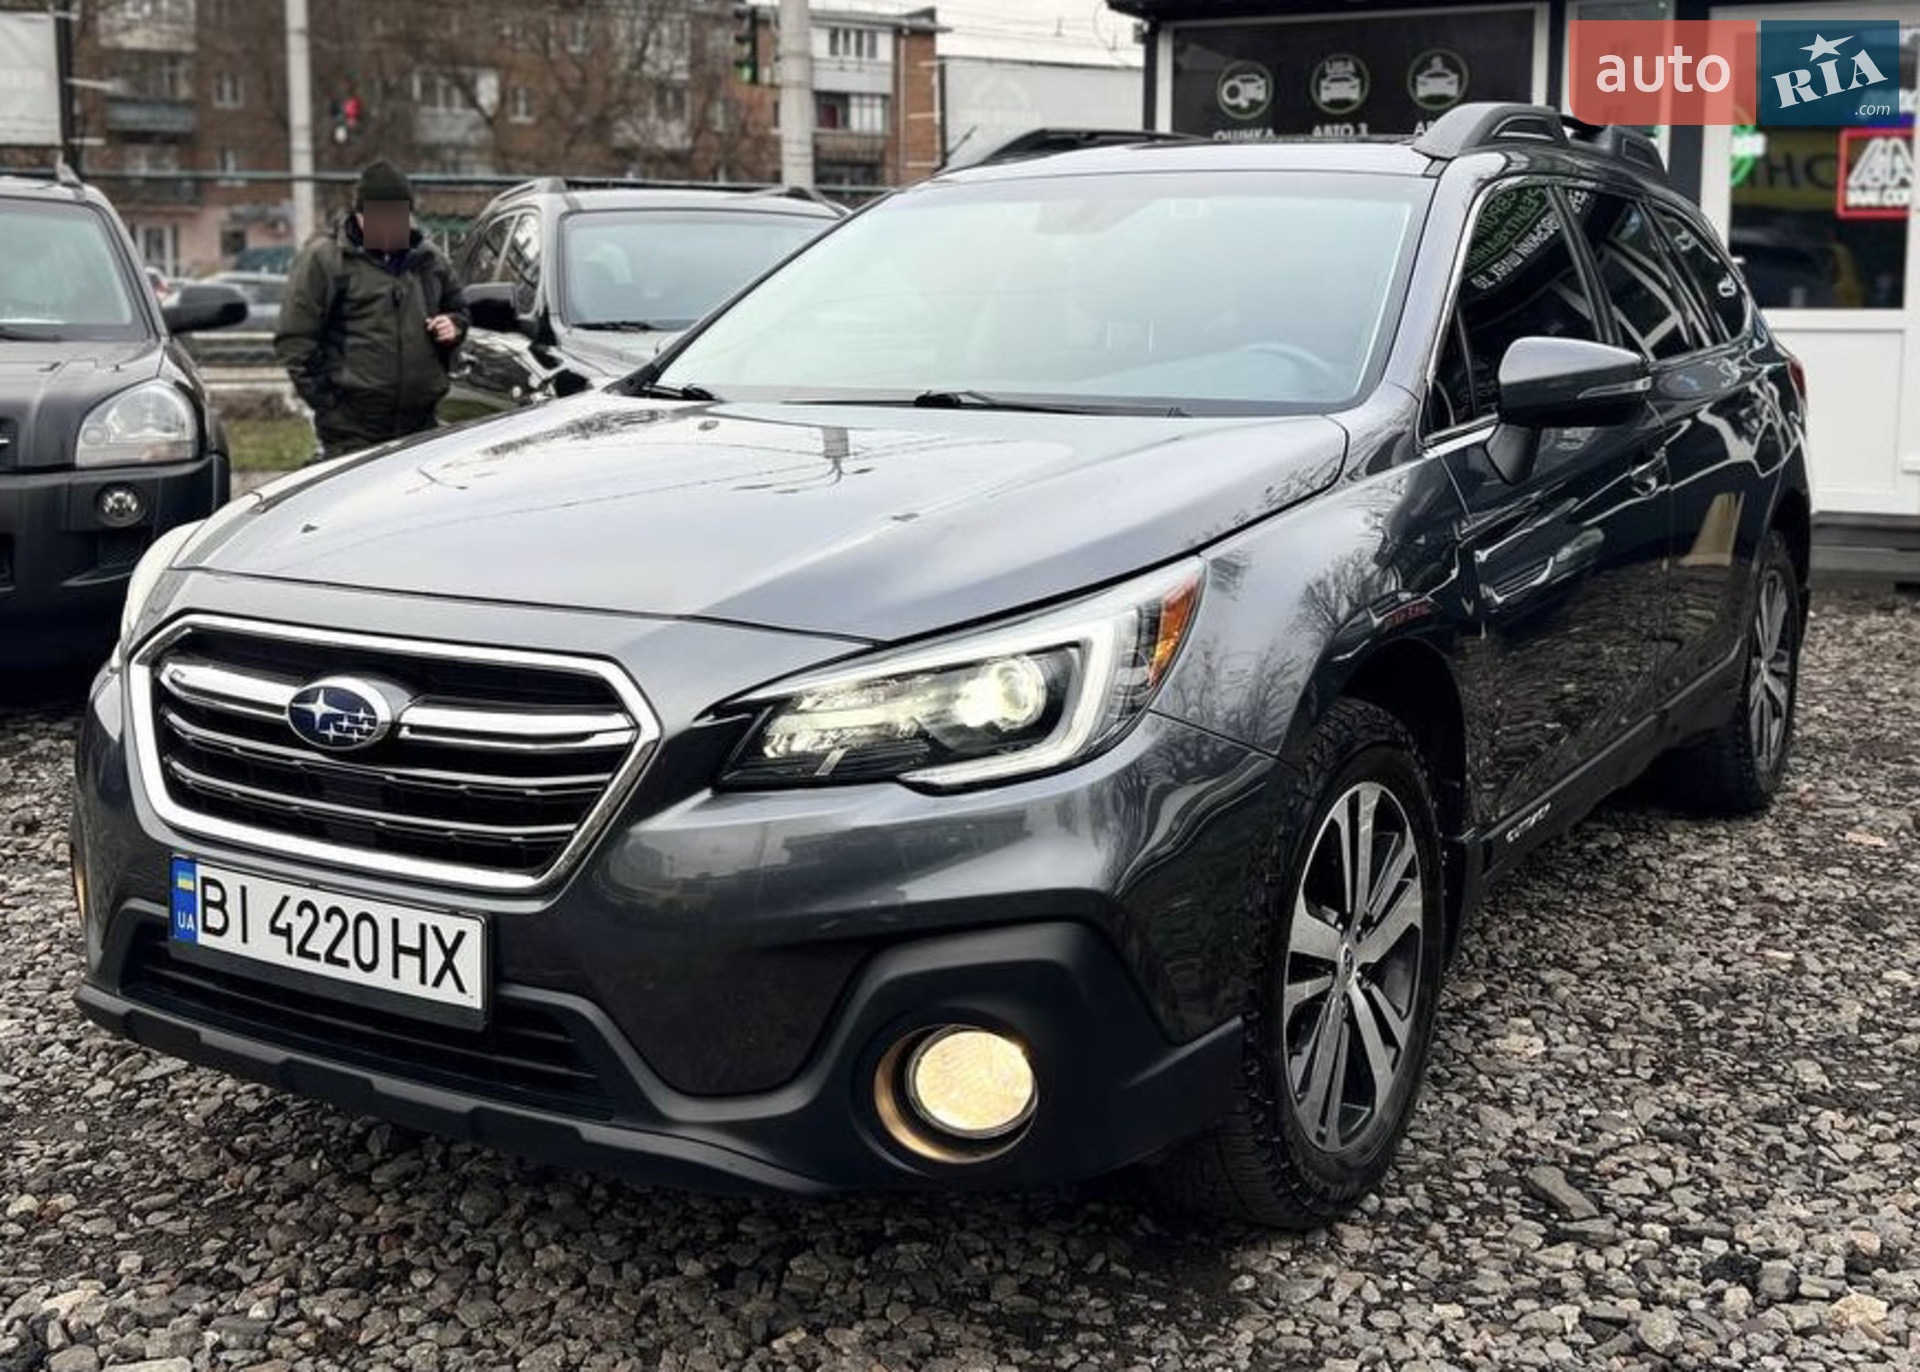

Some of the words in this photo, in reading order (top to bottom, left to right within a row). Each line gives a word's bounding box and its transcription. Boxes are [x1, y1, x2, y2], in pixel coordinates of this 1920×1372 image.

[177, 910, 195, 930] UA
[200, 876, 248, 944] BI
[268, 895, 379, 973] 4220
[391, 917, 467, 994] HX
